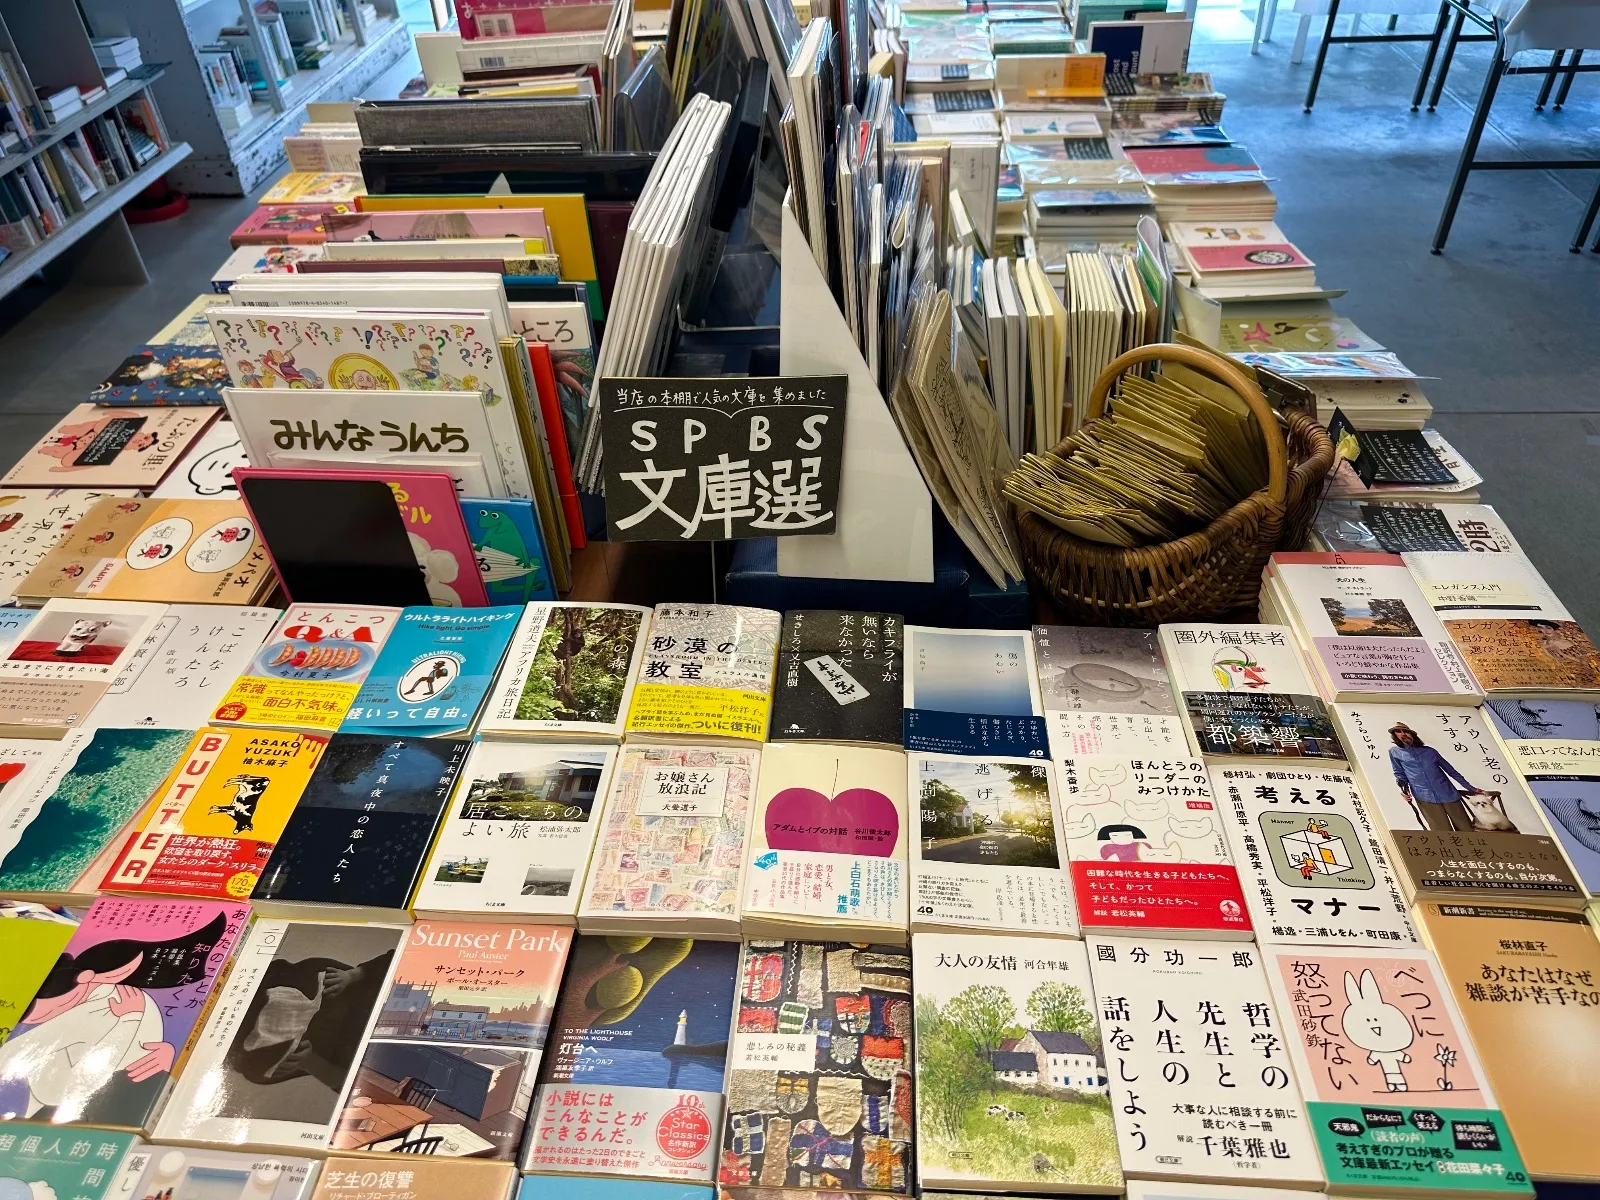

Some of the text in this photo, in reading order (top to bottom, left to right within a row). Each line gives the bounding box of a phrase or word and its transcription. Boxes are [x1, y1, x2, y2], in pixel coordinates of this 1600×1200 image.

[617, 386, 826, 405] 当店の本棚で人気の文庫を集めました
[269, 419, 470, 452] みんなうんち
[615, 453, 833, 539] 文庫選
[88, 562, 114, 589] SAMPLE
[296, 611, 386, 625] とんこつ
[404, 612, 516, 624] ウルトラライトハイキング
[659, 608, 714, 618] 藤本和子
[525, 607, 548, 643] 星野道夫
[283, 625, 378, 643] Q&A
[837, 615, 855, 668] 来なかった
[861, 616, 878, 660] 無いなら
[1174, 630, 1286, 646] 圏外編集者
[111, 621, 167, 687] 小林賢太郎
[652, 636, 739, 655] 砂漠の
[786, 615, 804, 687] せきしろ×又吉直樹
[881, 616, 899, 682] カキフライが
[198, 626, 245, 689] こばなし
[0, 663, 109, 673] 死ぬまでに行きたい海
[280, 669, 334, 680] 今村夏子
[645, 662, 702, 678] 教室
[497, 651, 534, 719] アフリカ旅日記
[263, 697, 342, 712] 面白不気味。
[344, 707, 469, 720] 軽いって自由。
[968, 718, 976, 735] 生きる
[1435, 714, 1469, 754] すすめ
[250, 738, 301, 748] ASAKO
[1350, 712, 1380, 760] みうらじゅん
[244, 747, 300, 758] YUZUKI
[1458, 715, 1509, 785] アウト老の
[242, 757, 288, 768] 柚木麻子
[435, 743, 465, 797] 川上未映子
[1131, 760, 1203, 771] ほんとうの
[654, 770, 714, 784] お嬢さん
[1064, 759, 1079, 793] 梨木香歩
[1133, 772, 1207, 783] リーダーの
[657, 783, 707, 796] 放浪記
[975, 763, 994, 826] 逃げる
[1137, 786, 1211, 798] みつけかた
[1254, 785, 1336, 806] 考える
[332, 740, 405, 884] すべて真夜中の恋人たち
[465, 802, 583, 819] 居ごこちの
[662, 803, 698, 812] 犬養道子
[921, 761, 937, 851] 上間陽子
[462, 822, 531, 839] よい旅
[539, 825, 582, 834] 松浦弥太郎
[772, 822, 848, 837] アダムとイブの対話
[171, 836, 241, 851] 世界が熱狂。
[1401, 835, 1488, 847] アウト老とは
[164, 847, 232, 859] 欲望を取り戻す、
[1408, 847, 1559, 862] はみ出し老人のことなり
[158, 857, 263, 871] 女たちのダーク・スリラー
[1439, 859, 1541, 872] 人生を面白くするのも、
[813, 864, 823, 903] 恋愛、結婚、
[825, 865, 834, 890] 男と女、
[1086, 869, 1230, 881] 困難な時代を生きる子どもたちへ、
[1426, 869, 1563, 883] つまらなくするのも、自分次第。
[1089, 882, 1153, 891] そして、かつて
[837, 894, 848, 914] 推薦
[1091, 896, 1199, 906] 子どもだったひとたちへ。
[1290, 898, 1381, 917] マナー
[411, 924, 564, 953] Sunset Park
[1499, 939, 1548, 951] 桜林直子
[185, 909, 246, 1008] あなたのことが
[458, 950, 509, 961] Paul Auster
[935, 953, 1070, 971] 大人の友情 河合隼雄
[1096, 944, 1253, 969] 國分功一郎
[434, 965, 525, 977] サンセット・パーク
[1481, 964, 1594, 986] あなたはなぜ
[165, 943, 211, 1017] 知りたくて
[447, 978, 508, 986] ポール・オースター
[1393, 967, 1445, 1038] べつに
[1464, 982, 1600, 1006] 雑談が苦手なの
[1290, 960, 1359, 1091] 怒ってない
[1291, 989, 1321, 1048] 武田砂鉄
[559, 1043, 598, 1055] 灯台へ
[746, 1041, 806, 1052] 悲しみの秘義
[1152, 999, 1190, 1085] 人生の
[1196, 1001, 1237, 1088] 先生と
[1242, 1002, 1289, 1090] 哲学の
[557, 1057, 614, 1065] ヴァージニア・ウルフ
[745, 1054, 778, 1062] 若松英輔
[1102, 996, 1147, 1151] 話をしよう
[546, 1091, 614, 1107] 小説には
[543, 1108, 649, 1126] こんなことが
[1172, 1103, 1298, 1119] 大事な人に相談する前に
[672, 1117, 700, 1129] Star
[1202, 1118, 1273, 1132] 読むべき一冊
[539, 1127, 633, 1145] できるんだ。
[658, 1125, 710, 1141] Classics
[534, 1146, 646, 1158] 描かれるのはたった2日のできごと
[668, 1140, 697, 1148] 名作新訳
[1196, 1135, 1291, 1159] 千葉雅也
[1335, 1142, 1454, 1159] 考えすぎのプロが贈る
[532, 1157, 640, 1168] 文学史を永遠に塗り替えた傑作
[1341, 1157, 1435, 1173] 文庫最新エッセイ
[1446, 1162, 1505, 1175] 花田菜々子
[324, 1171, 414, 1189] 芝生の復讐
[1506, 1171, 1526, 1182] 40
